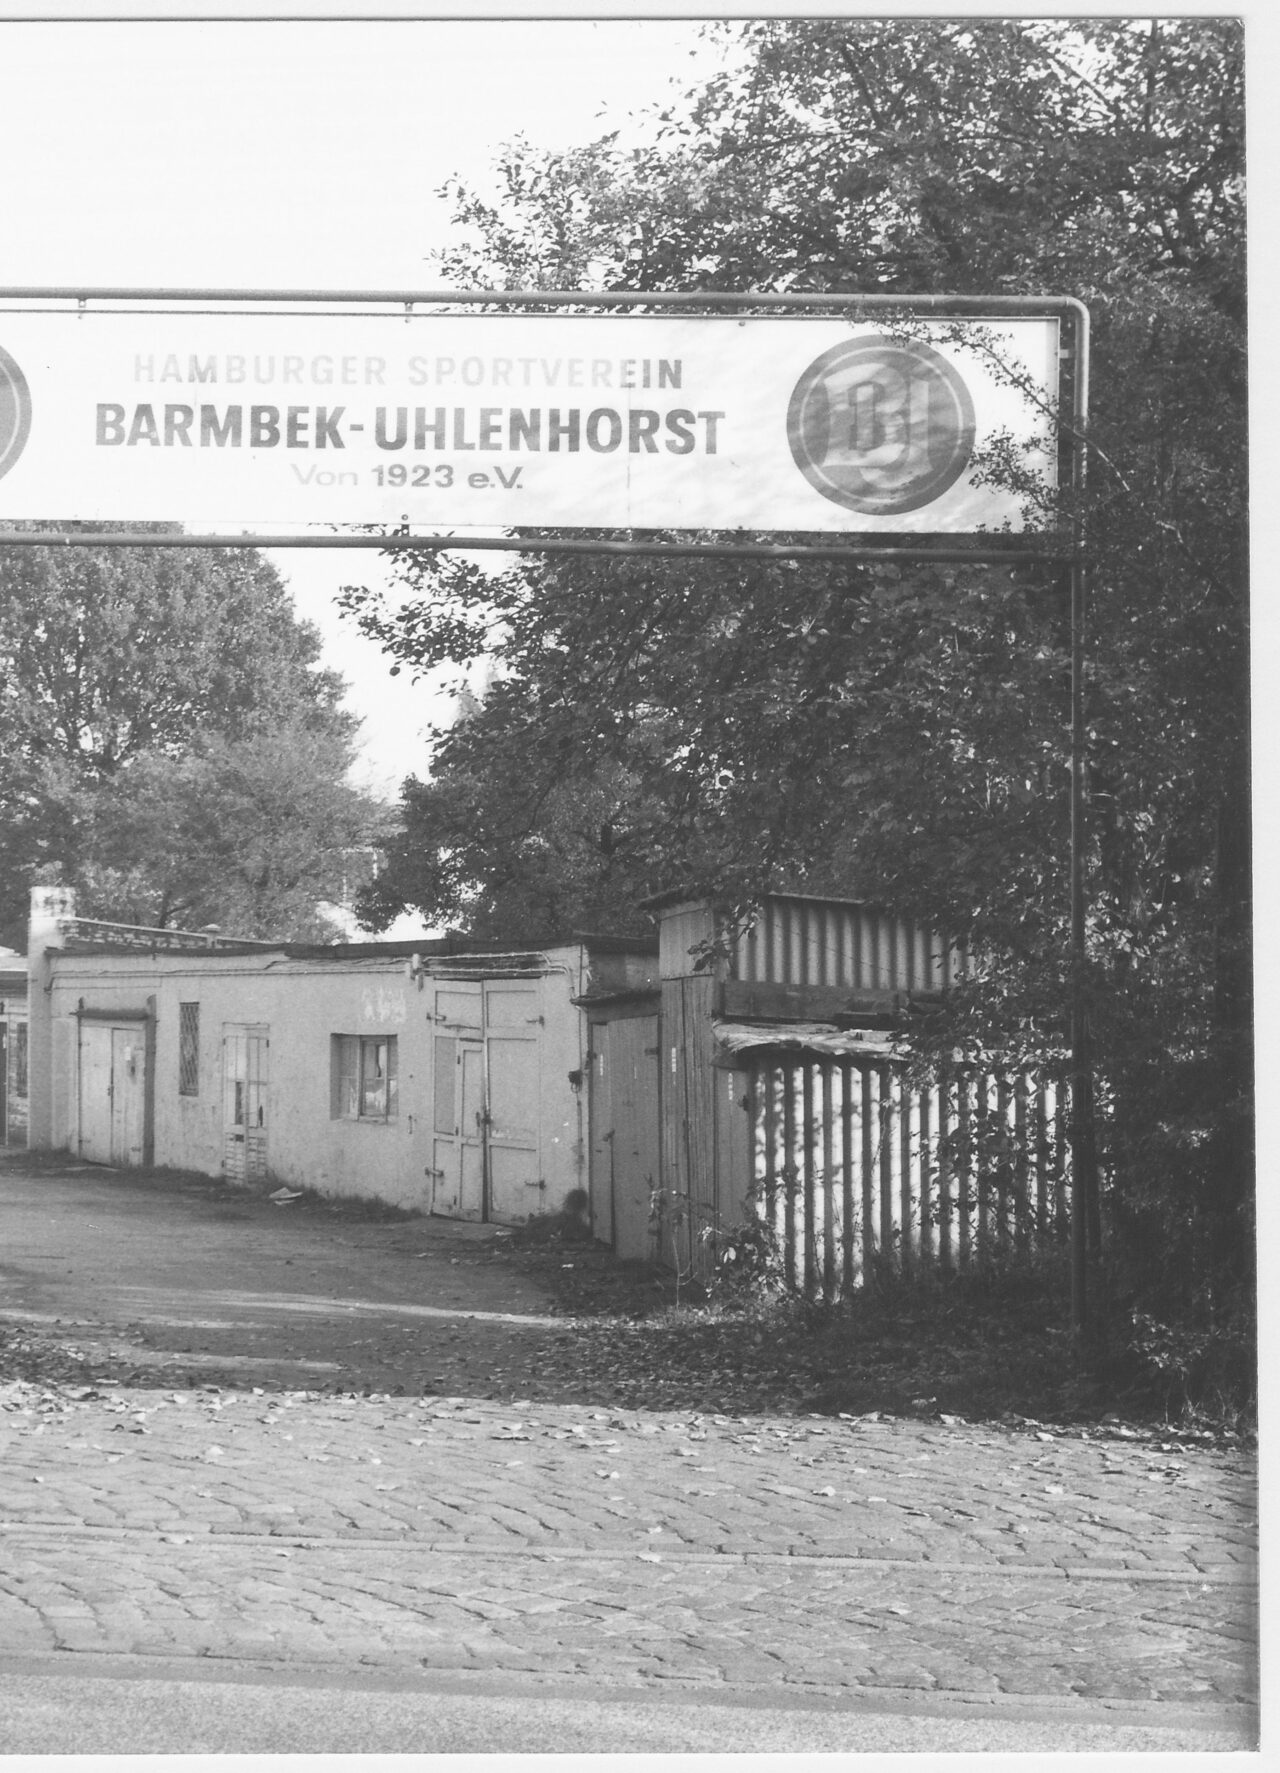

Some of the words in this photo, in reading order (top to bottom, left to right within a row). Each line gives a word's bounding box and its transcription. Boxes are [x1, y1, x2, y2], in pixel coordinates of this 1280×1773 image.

[133, 353, 387, 384] HAMBURGER
[408, 357, 683, 390] SPORTVEREIN
[95, 403, 726, 456] BARMBEK-UHLENHORST
[291, 463, 360, 486] Von
[371, 464, 455, 488] 1923
